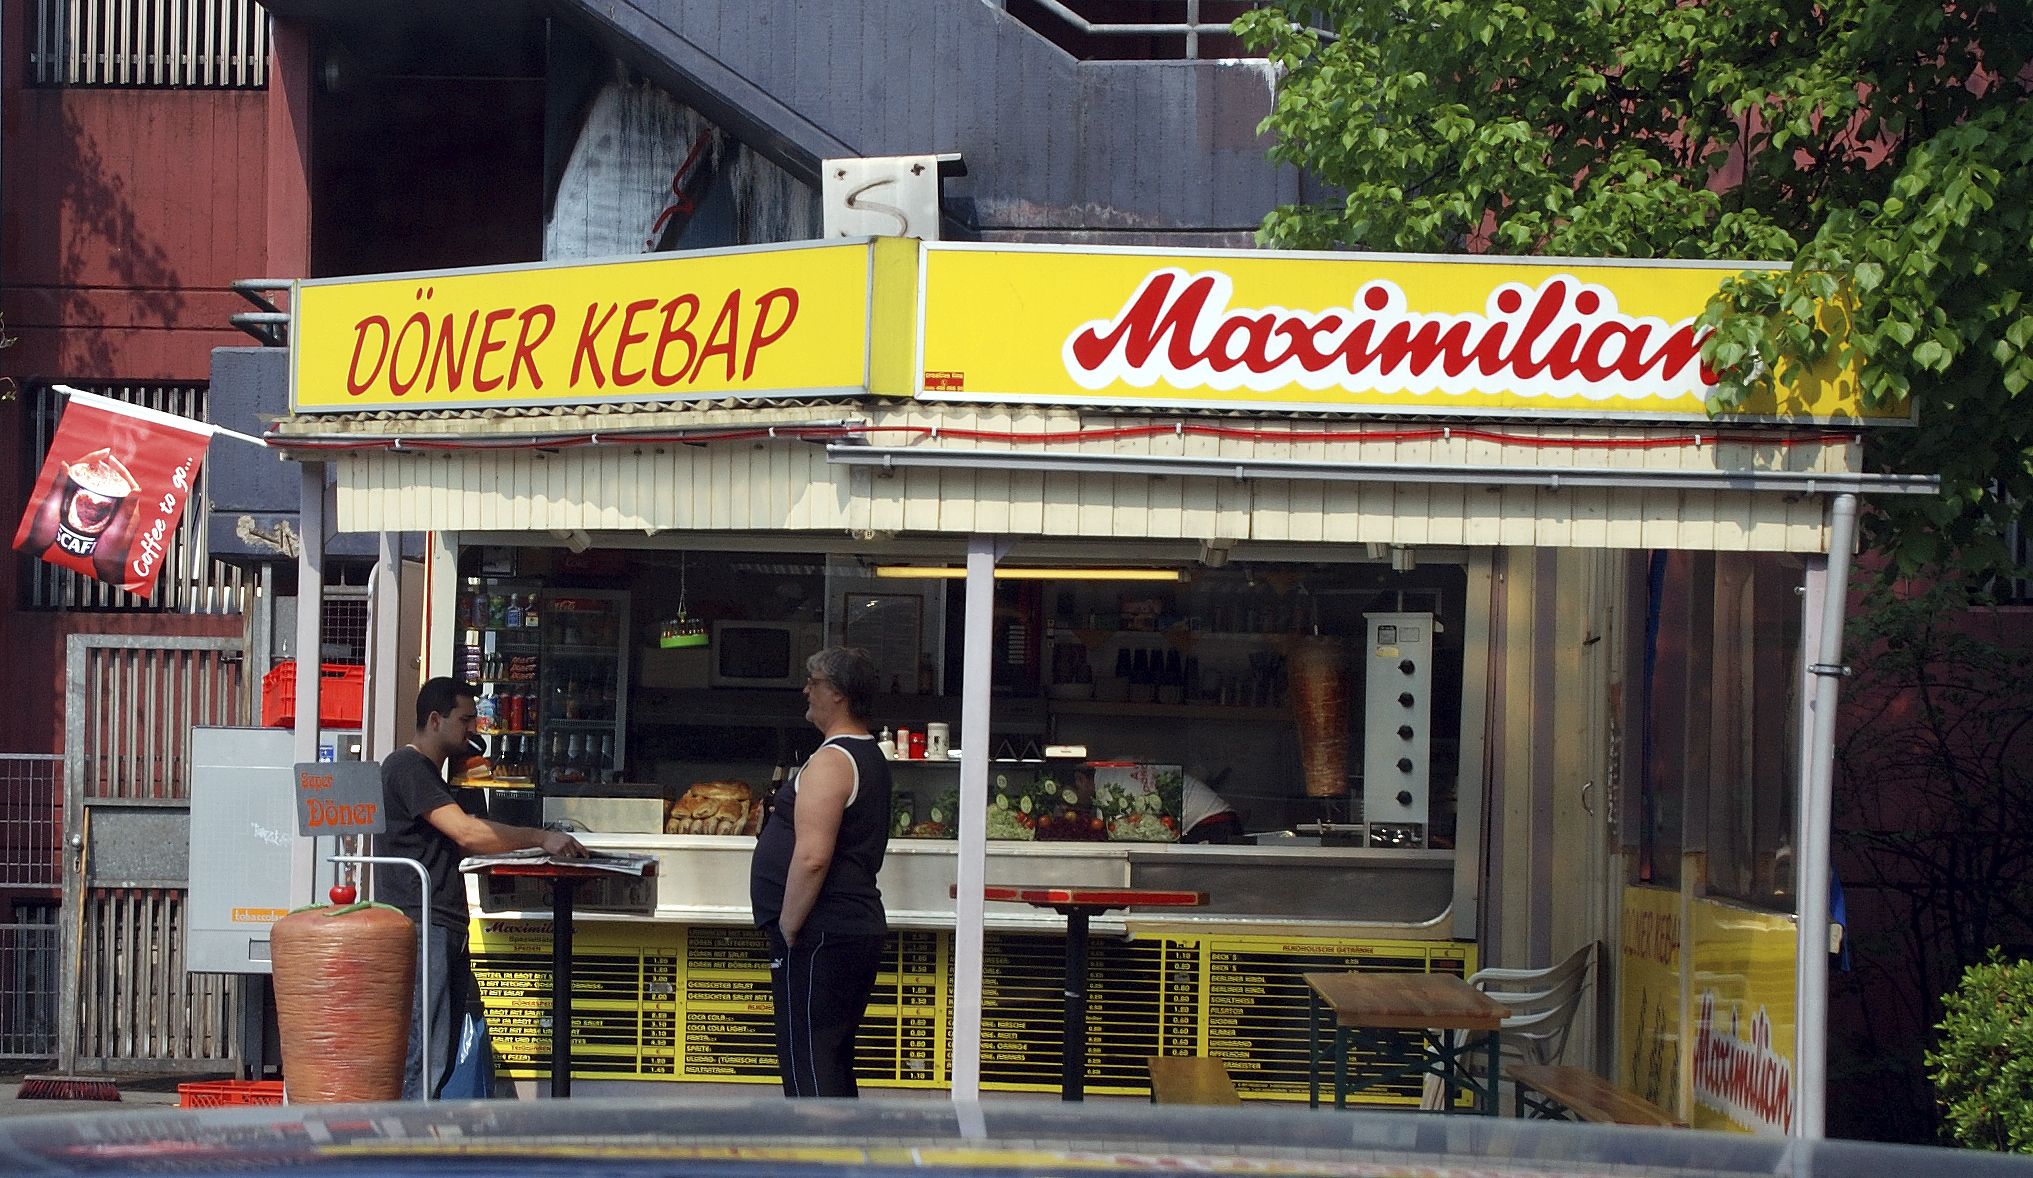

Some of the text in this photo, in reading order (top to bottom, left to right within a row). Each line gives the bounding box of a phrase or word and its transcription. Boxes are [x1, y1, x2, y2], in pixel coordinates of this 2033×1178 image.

[347, 287, 798, 397] DÖNER KEBAP
[1072, 272, 1722, 387] Maximilian
[132, 457, 193, 578] Coffee to go...
[301, 772, 333, 792] Super
[306, 799, 376, 827] Döner
